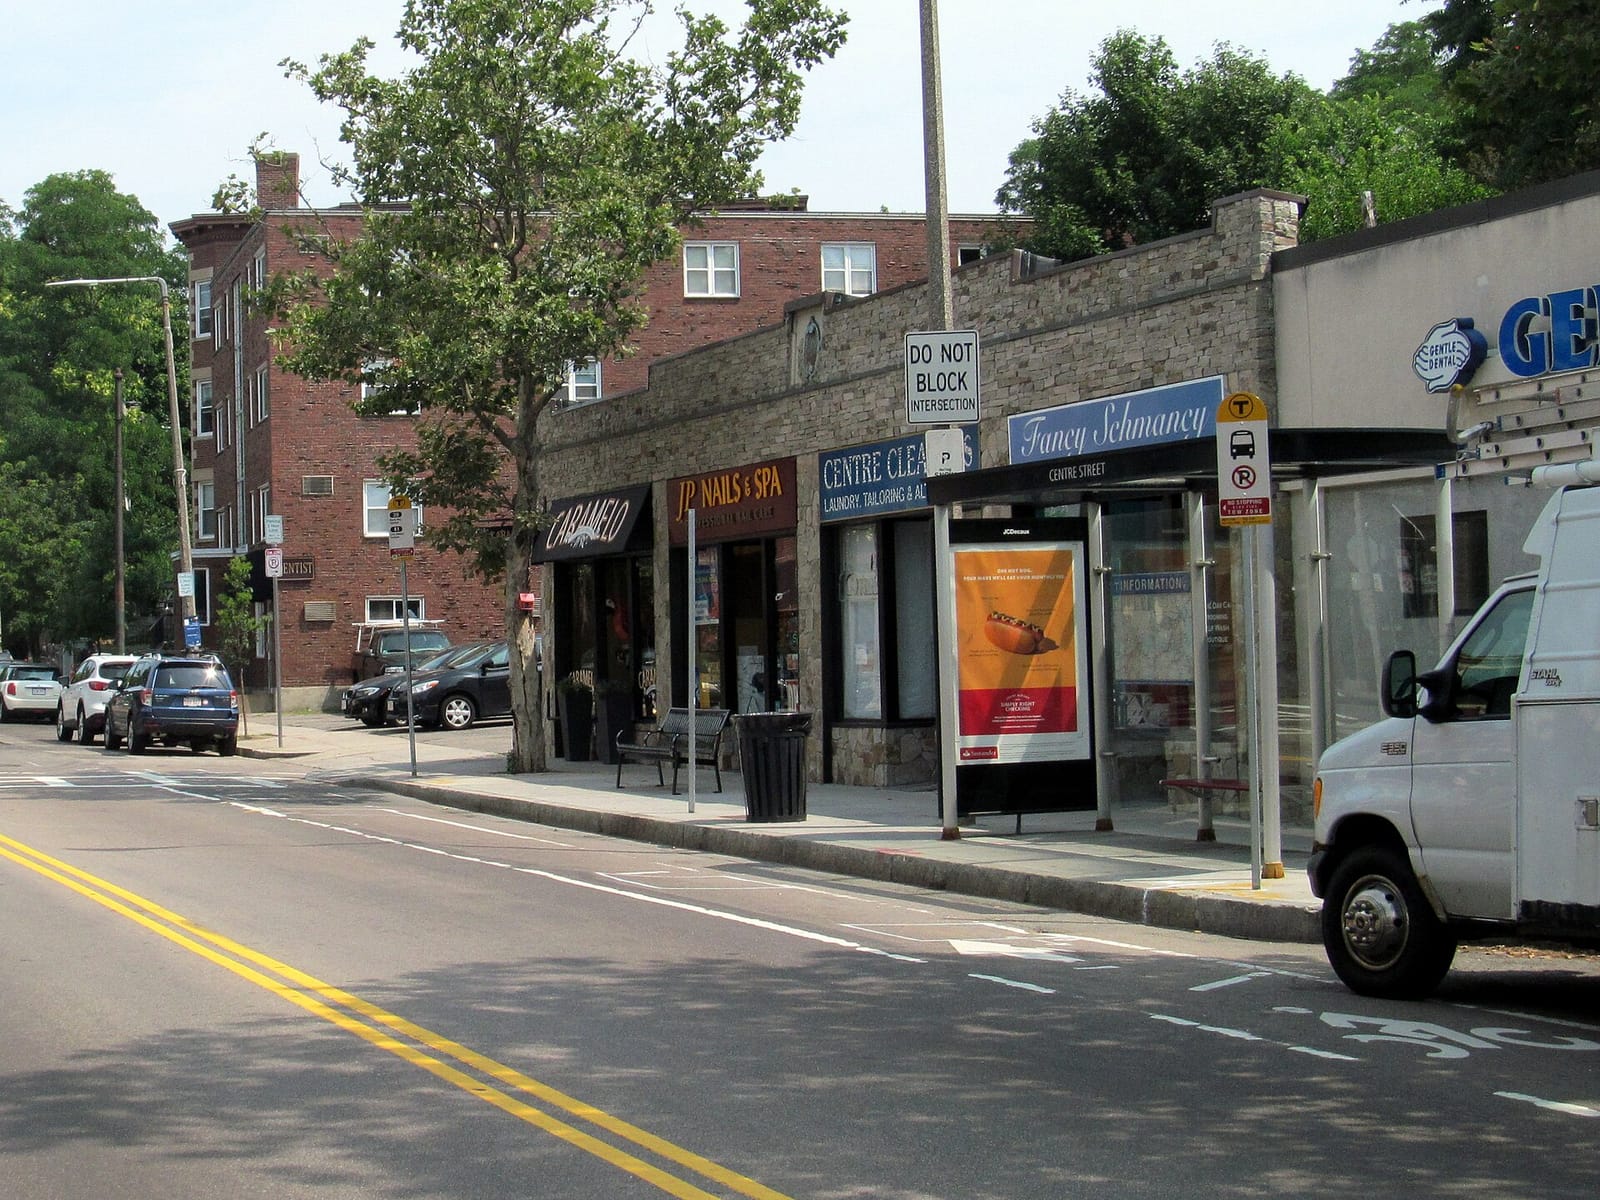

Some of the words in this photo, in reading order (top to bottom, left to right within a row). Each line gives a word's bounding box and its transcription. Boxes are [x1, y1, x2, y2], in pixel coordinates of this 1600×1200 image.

[1497, 283, 1600, 378] GE
[910, 344, 932, 364] DO
[941, 342, 973, 363] NOT
[1429, 341, 1456, 356] GENTLE
[1428, 355, 1456, 370] DENTAL
[916, 371, 968, 392] BLOCK
[910, 397, 976, 412] INTERSECTION
[1232, 400, 1249, 414] T
[1021, 415, 1086, 456] Fancy
[1093, 400, 1207, 446] Schmancy
[823, 451, 881, 490] CENTRE
[886, 434, 973, 480] CLEAS
[1049, 465, 1078, 482] CENTRE
[1078, 462, 1106, 478] STREET
[675, 480, 695, 521] JP
[701, 472, 741, 508] NAILS
[754, 465, 782, 500] SPA
[863, 485, 905, 507] TAILORING
[906, 485, 913, 500] &
[545, 498, 630, 550] CARAMELO
[283, 562, 313, 574] ENTIST
